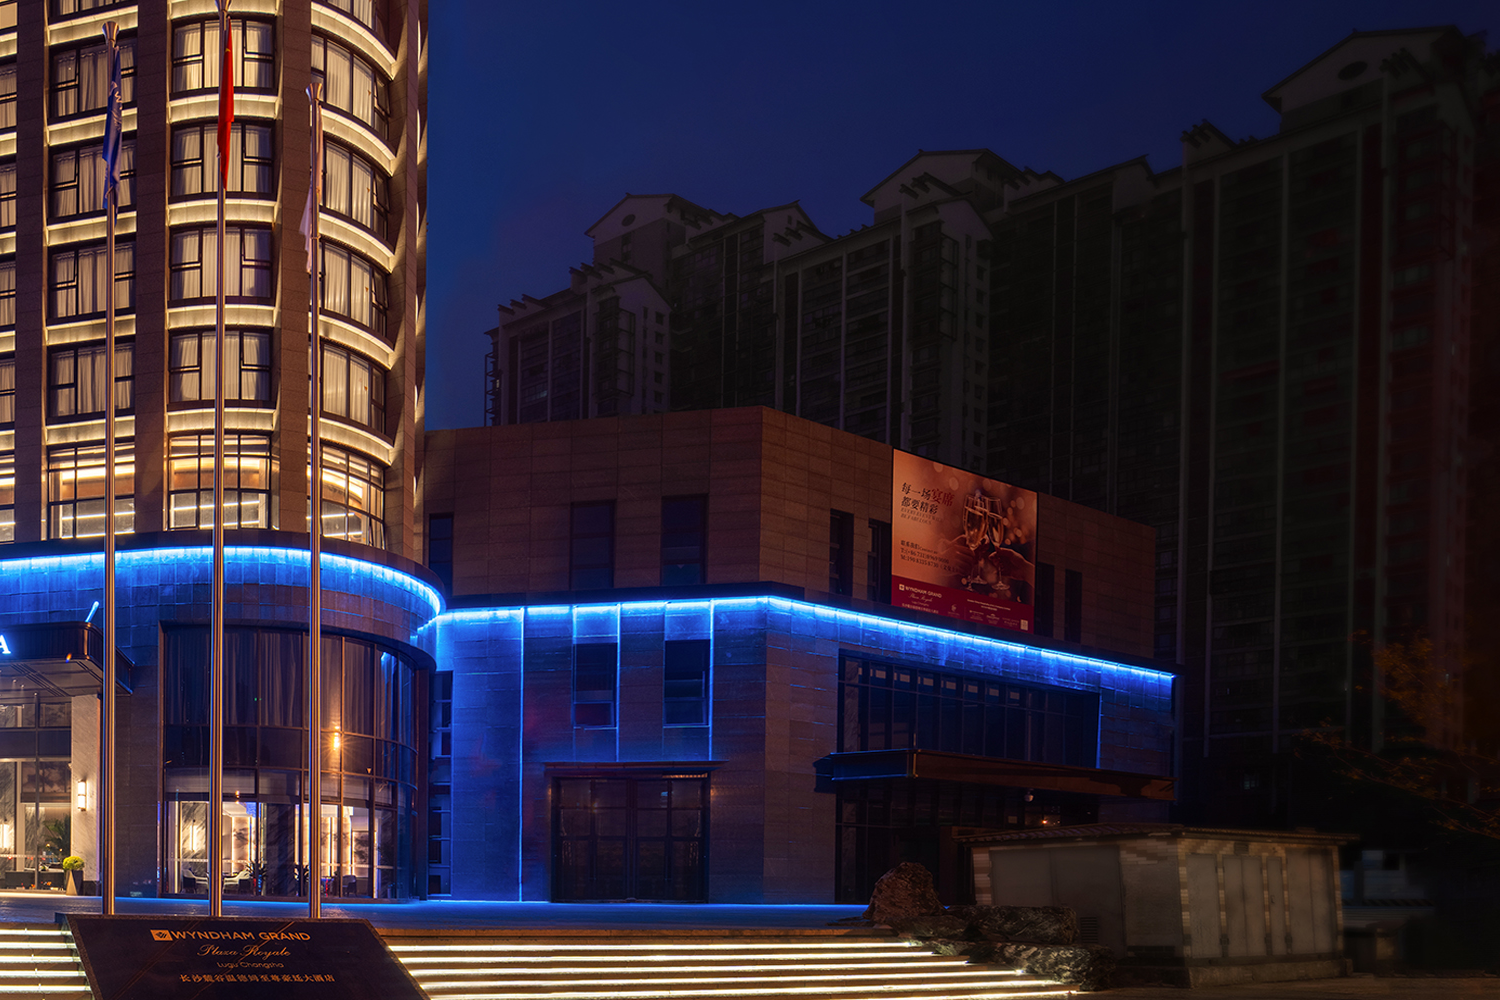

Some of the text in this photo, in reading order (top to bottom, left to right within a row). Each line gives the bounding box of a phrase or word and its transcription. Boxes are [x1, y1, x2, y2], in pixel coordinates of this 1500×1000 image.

[171, 930, 311, 941] WYNDHAM GRAND
[197, 944, 291, 960] Plaza Royale
[217, 961, 285, 969] Lugu Changsha
